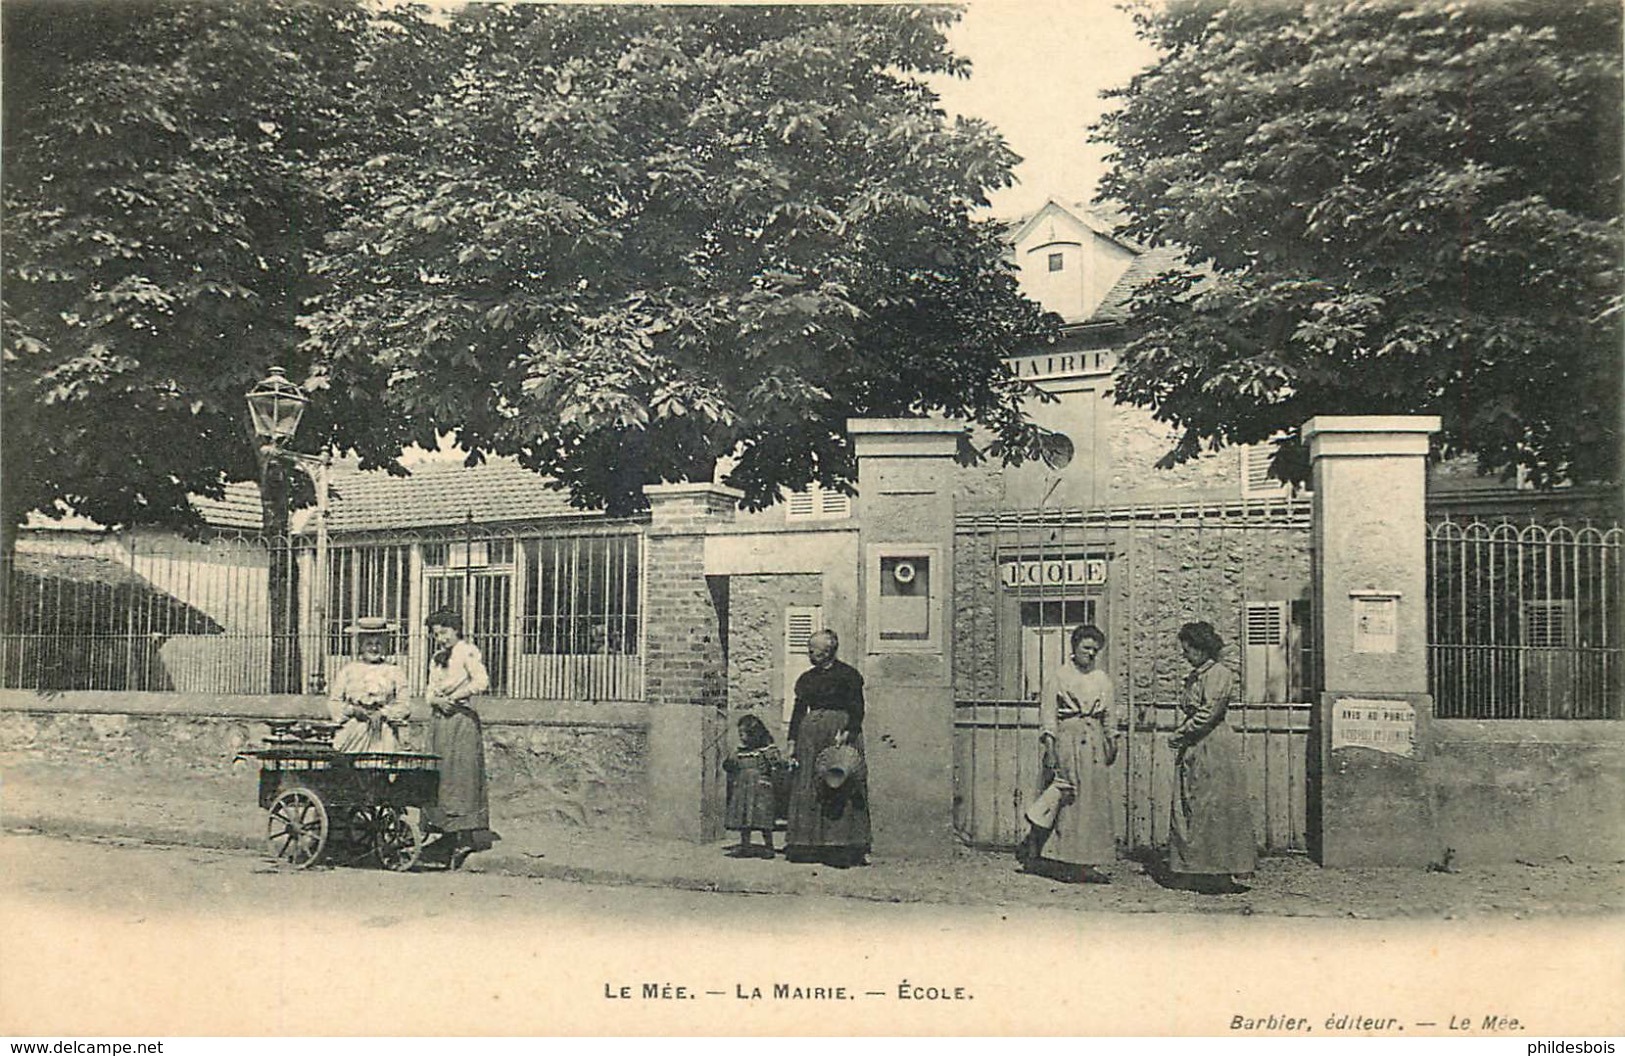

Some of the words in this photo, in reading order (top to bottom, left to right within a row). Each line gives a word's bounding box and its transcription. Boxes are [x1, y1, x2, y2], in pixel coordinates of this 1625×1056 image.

[1004, 352, 1110, 377] MAIRIE
[1342, 710, 1361, 720] AVIS
[1368, 711, 1378, 721] AU
